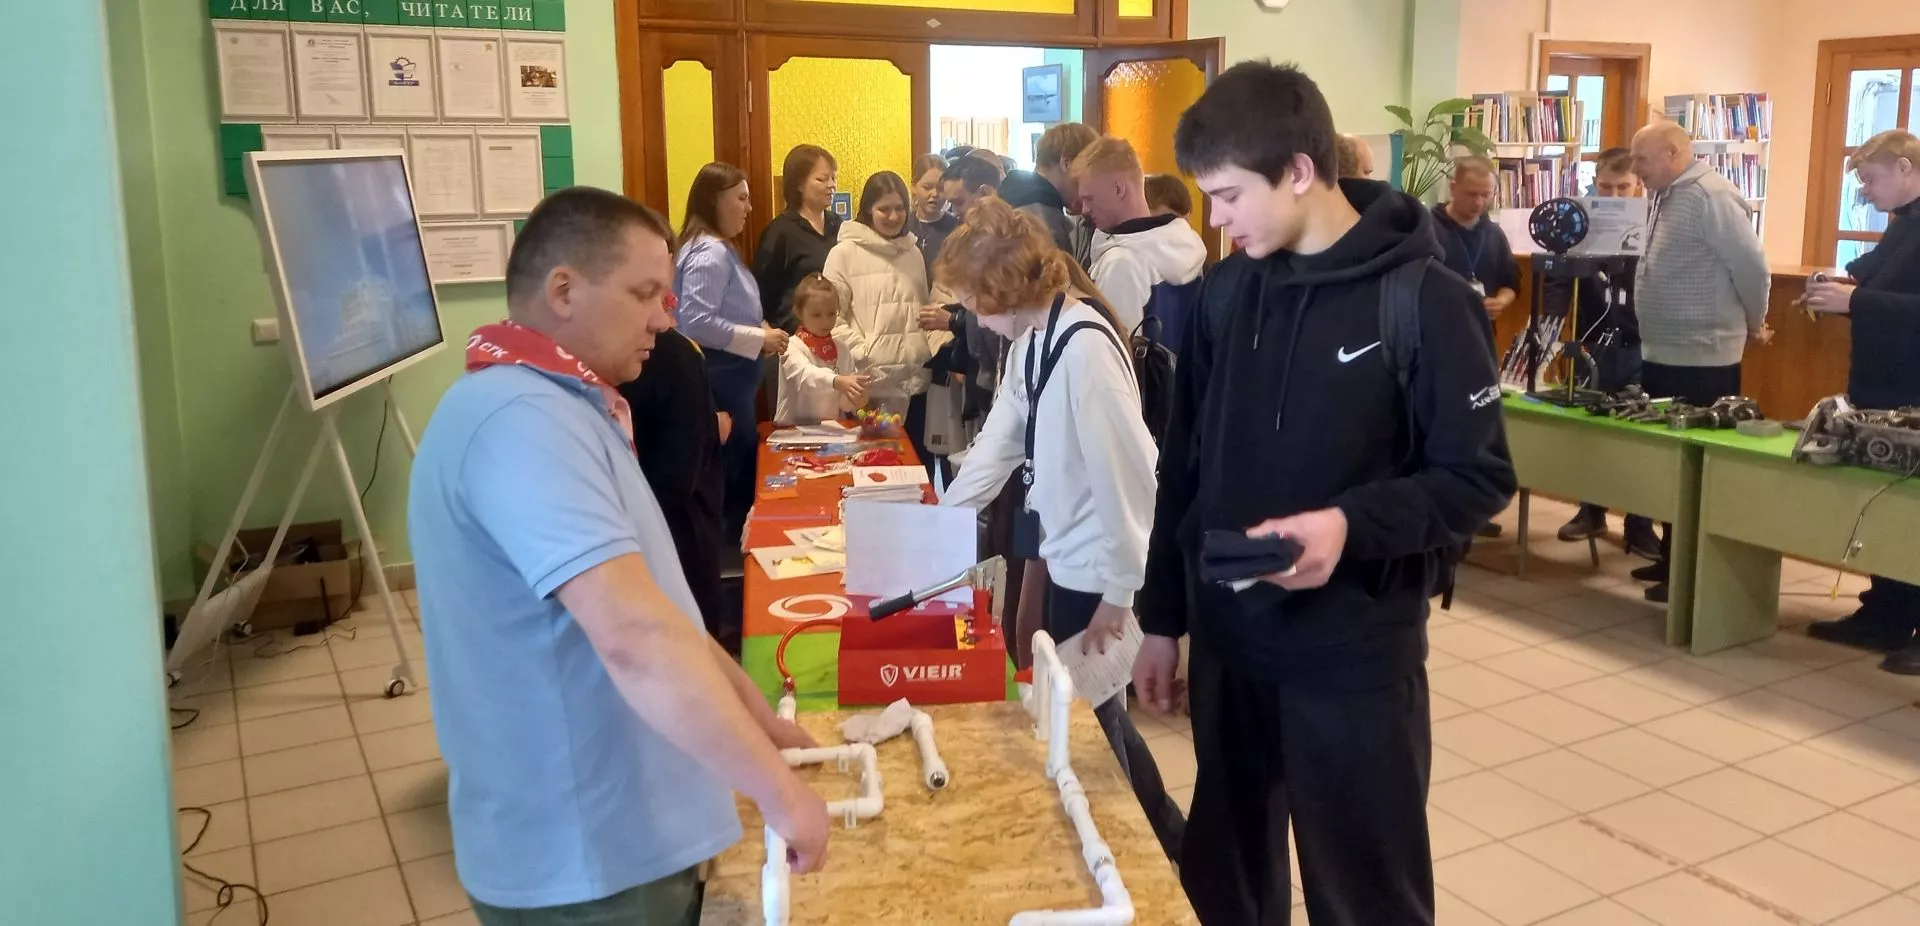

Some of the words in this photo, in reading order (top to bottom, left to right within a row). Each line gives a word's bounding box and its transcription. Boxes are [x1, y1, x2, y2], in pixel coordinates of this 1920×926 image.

[230, 0, 286, 11] ДЛЯ
[311, 0, 369, 18] ВАС,
[402, 2, 532, 21] ЧИТАТЕЛИ
[903, 664, 963, 679] VIEIR
